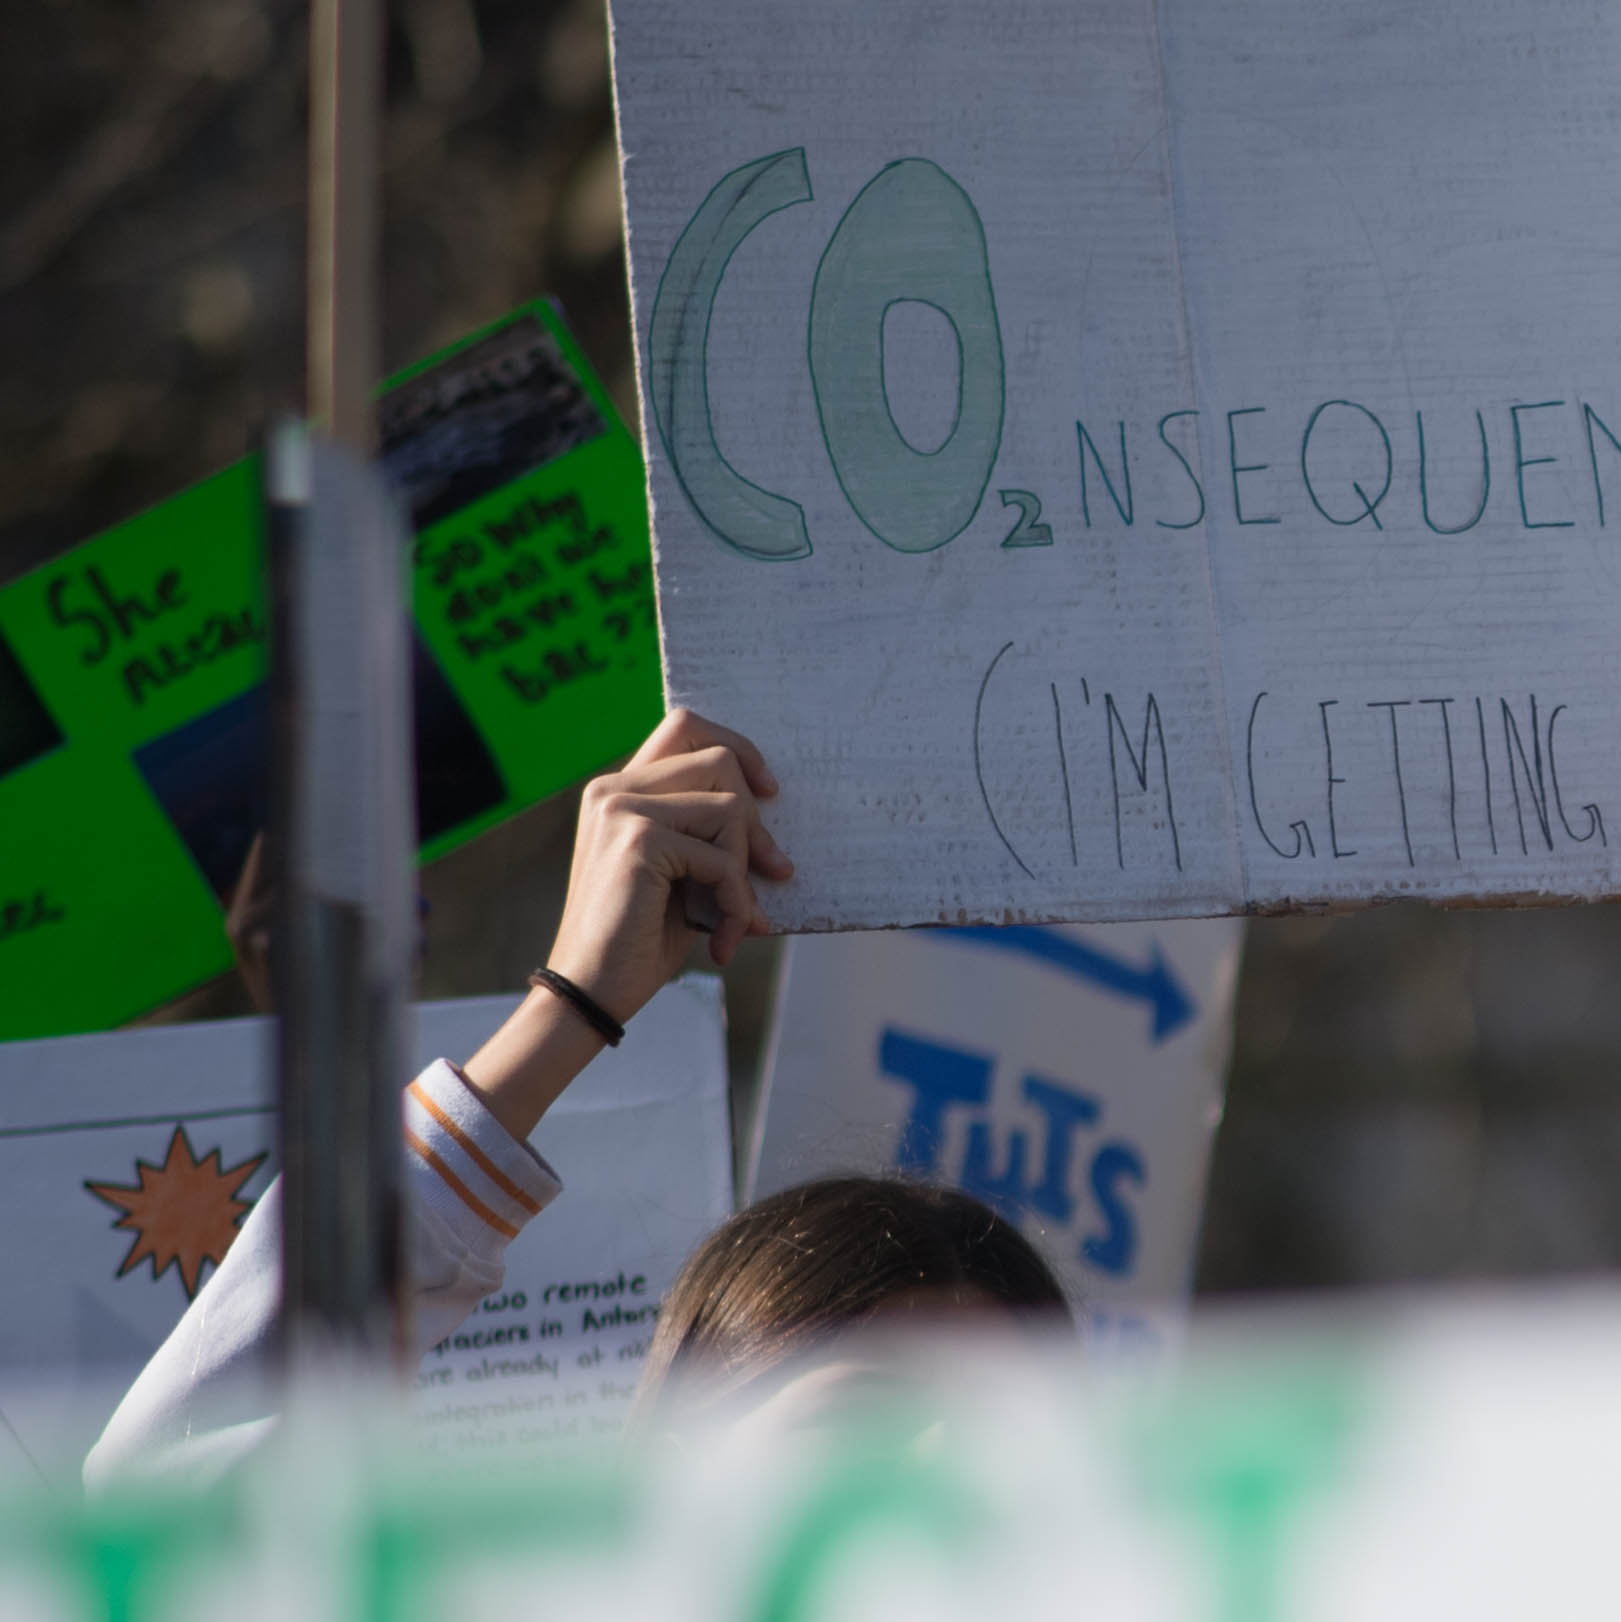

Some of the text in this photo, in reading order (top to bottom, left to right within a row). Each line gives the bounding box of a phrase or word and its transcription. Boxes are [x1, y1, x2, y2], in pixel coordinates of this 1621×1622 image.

[46, 562, 190, 669] She
[975, 641, 1183, 879] (I'M
[1247, 694, 1607, 867] GETTING
[472, 1271, 647, 1316] wo remote
[539, 1316, 564, 1340] in
[465, 1353, 560, 1382] already
